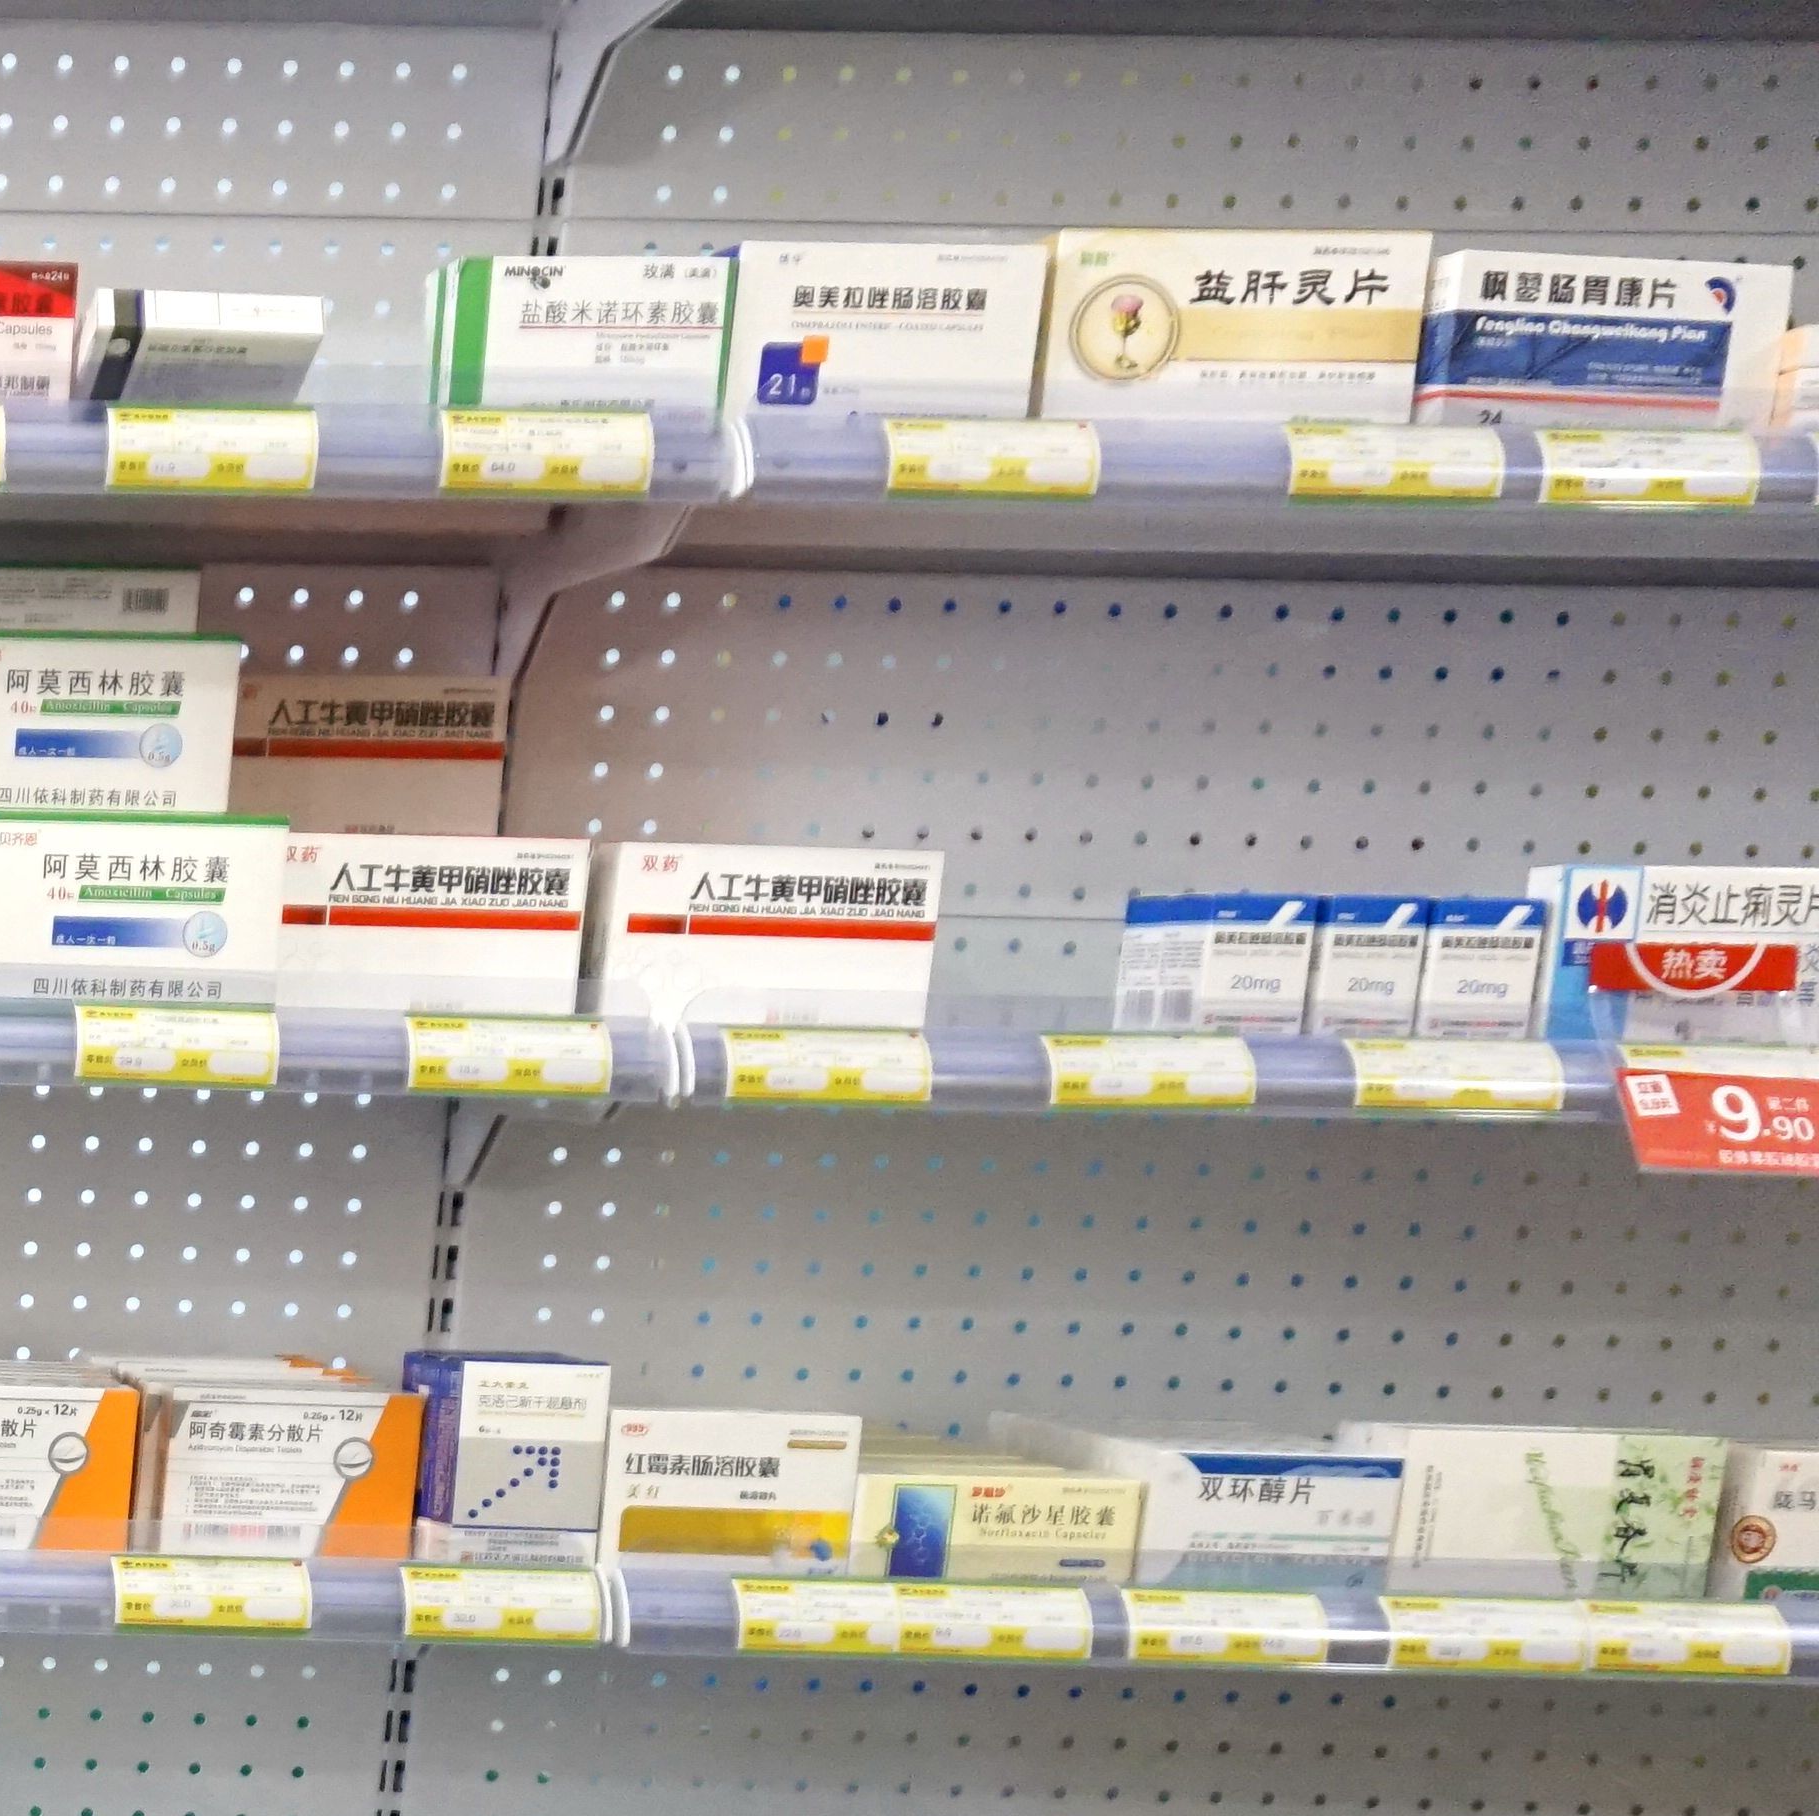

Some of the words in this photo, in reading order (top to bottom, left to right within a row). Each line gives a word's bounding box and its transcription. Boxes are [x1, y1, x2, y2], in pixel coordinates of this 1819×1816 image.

[792, 285, 988, 313] 奥美拉唑肠溶胶囊
[1189, 268, 1392, 307] 益肝灵片
[520, 300, 720, 327] 盐酸米诺环素胶囊
[6, 668, 187, 697] 阿莫西林胶囊
[268, 699, 495, 728] 人工牛黄甲硝唑胶囊
[43, 853, 231, 884] 阿莫西林胶囊
[328, 861, 571, 897] 人工牛黄甲硝唑胶囊
[688, 873, 929, 907] 人工牛黄甲硝唑胶囊
[1661, 948, 1730, 980] 热卖
[32, 977, 223, 1000] 四川依科制药有限公司
[1230, 973, 1282, 992] 20mg
[1347, 975, 1396, 994] 20mg
[1457, 978, 1509, 997] 20mg
[188, 1420, 323, 1443] 阿奇霉素分散片
[625, 1451, 780, 1479] 红霉素肠溶胶囊
[1199, 1475, 1316, 1506] 双环醇片
[970, 1503, 1116, 1527] 诺氟沙星胶囊
